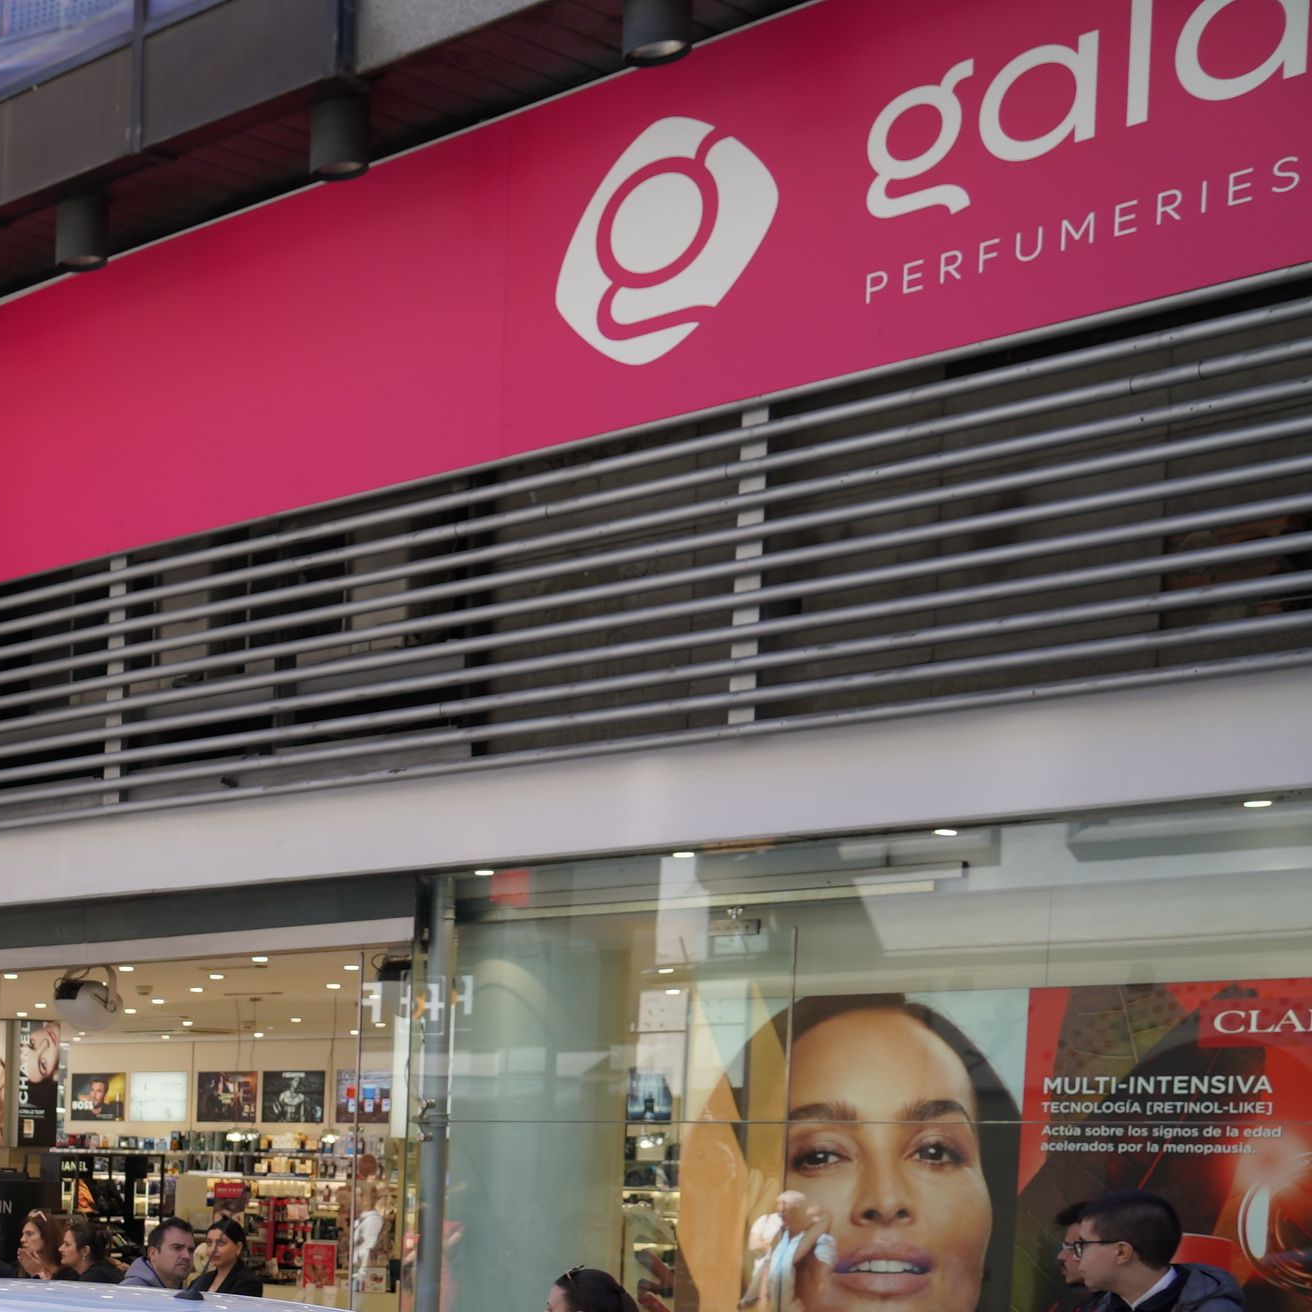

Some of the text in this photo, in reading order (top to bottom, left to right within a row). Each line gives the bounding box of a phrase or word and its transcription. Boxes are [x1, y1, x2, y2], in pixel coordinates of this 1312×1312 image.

[867, 0, 1312, 219] gala
[866, 156, 1300, 304] PERFUMERIES
[19, 1021, 31, 1104] CHANEL
[1043, 1075, 1273, 1095] MULTI-INTENSIVA
[72, 1101, 94, 1110] BOSS
[1042, 1099, 1273, 1115] TECNOLOGÍA [RETINOL-LIKE]
[1042, 1124, 1282, 1140] Actúa sobre los signos de la edad
[1041, 1141, 1114, 1153] acelerados
[1118, 1144, 1140, 1154] por
[1146, 1141, 1159, 1153] la
